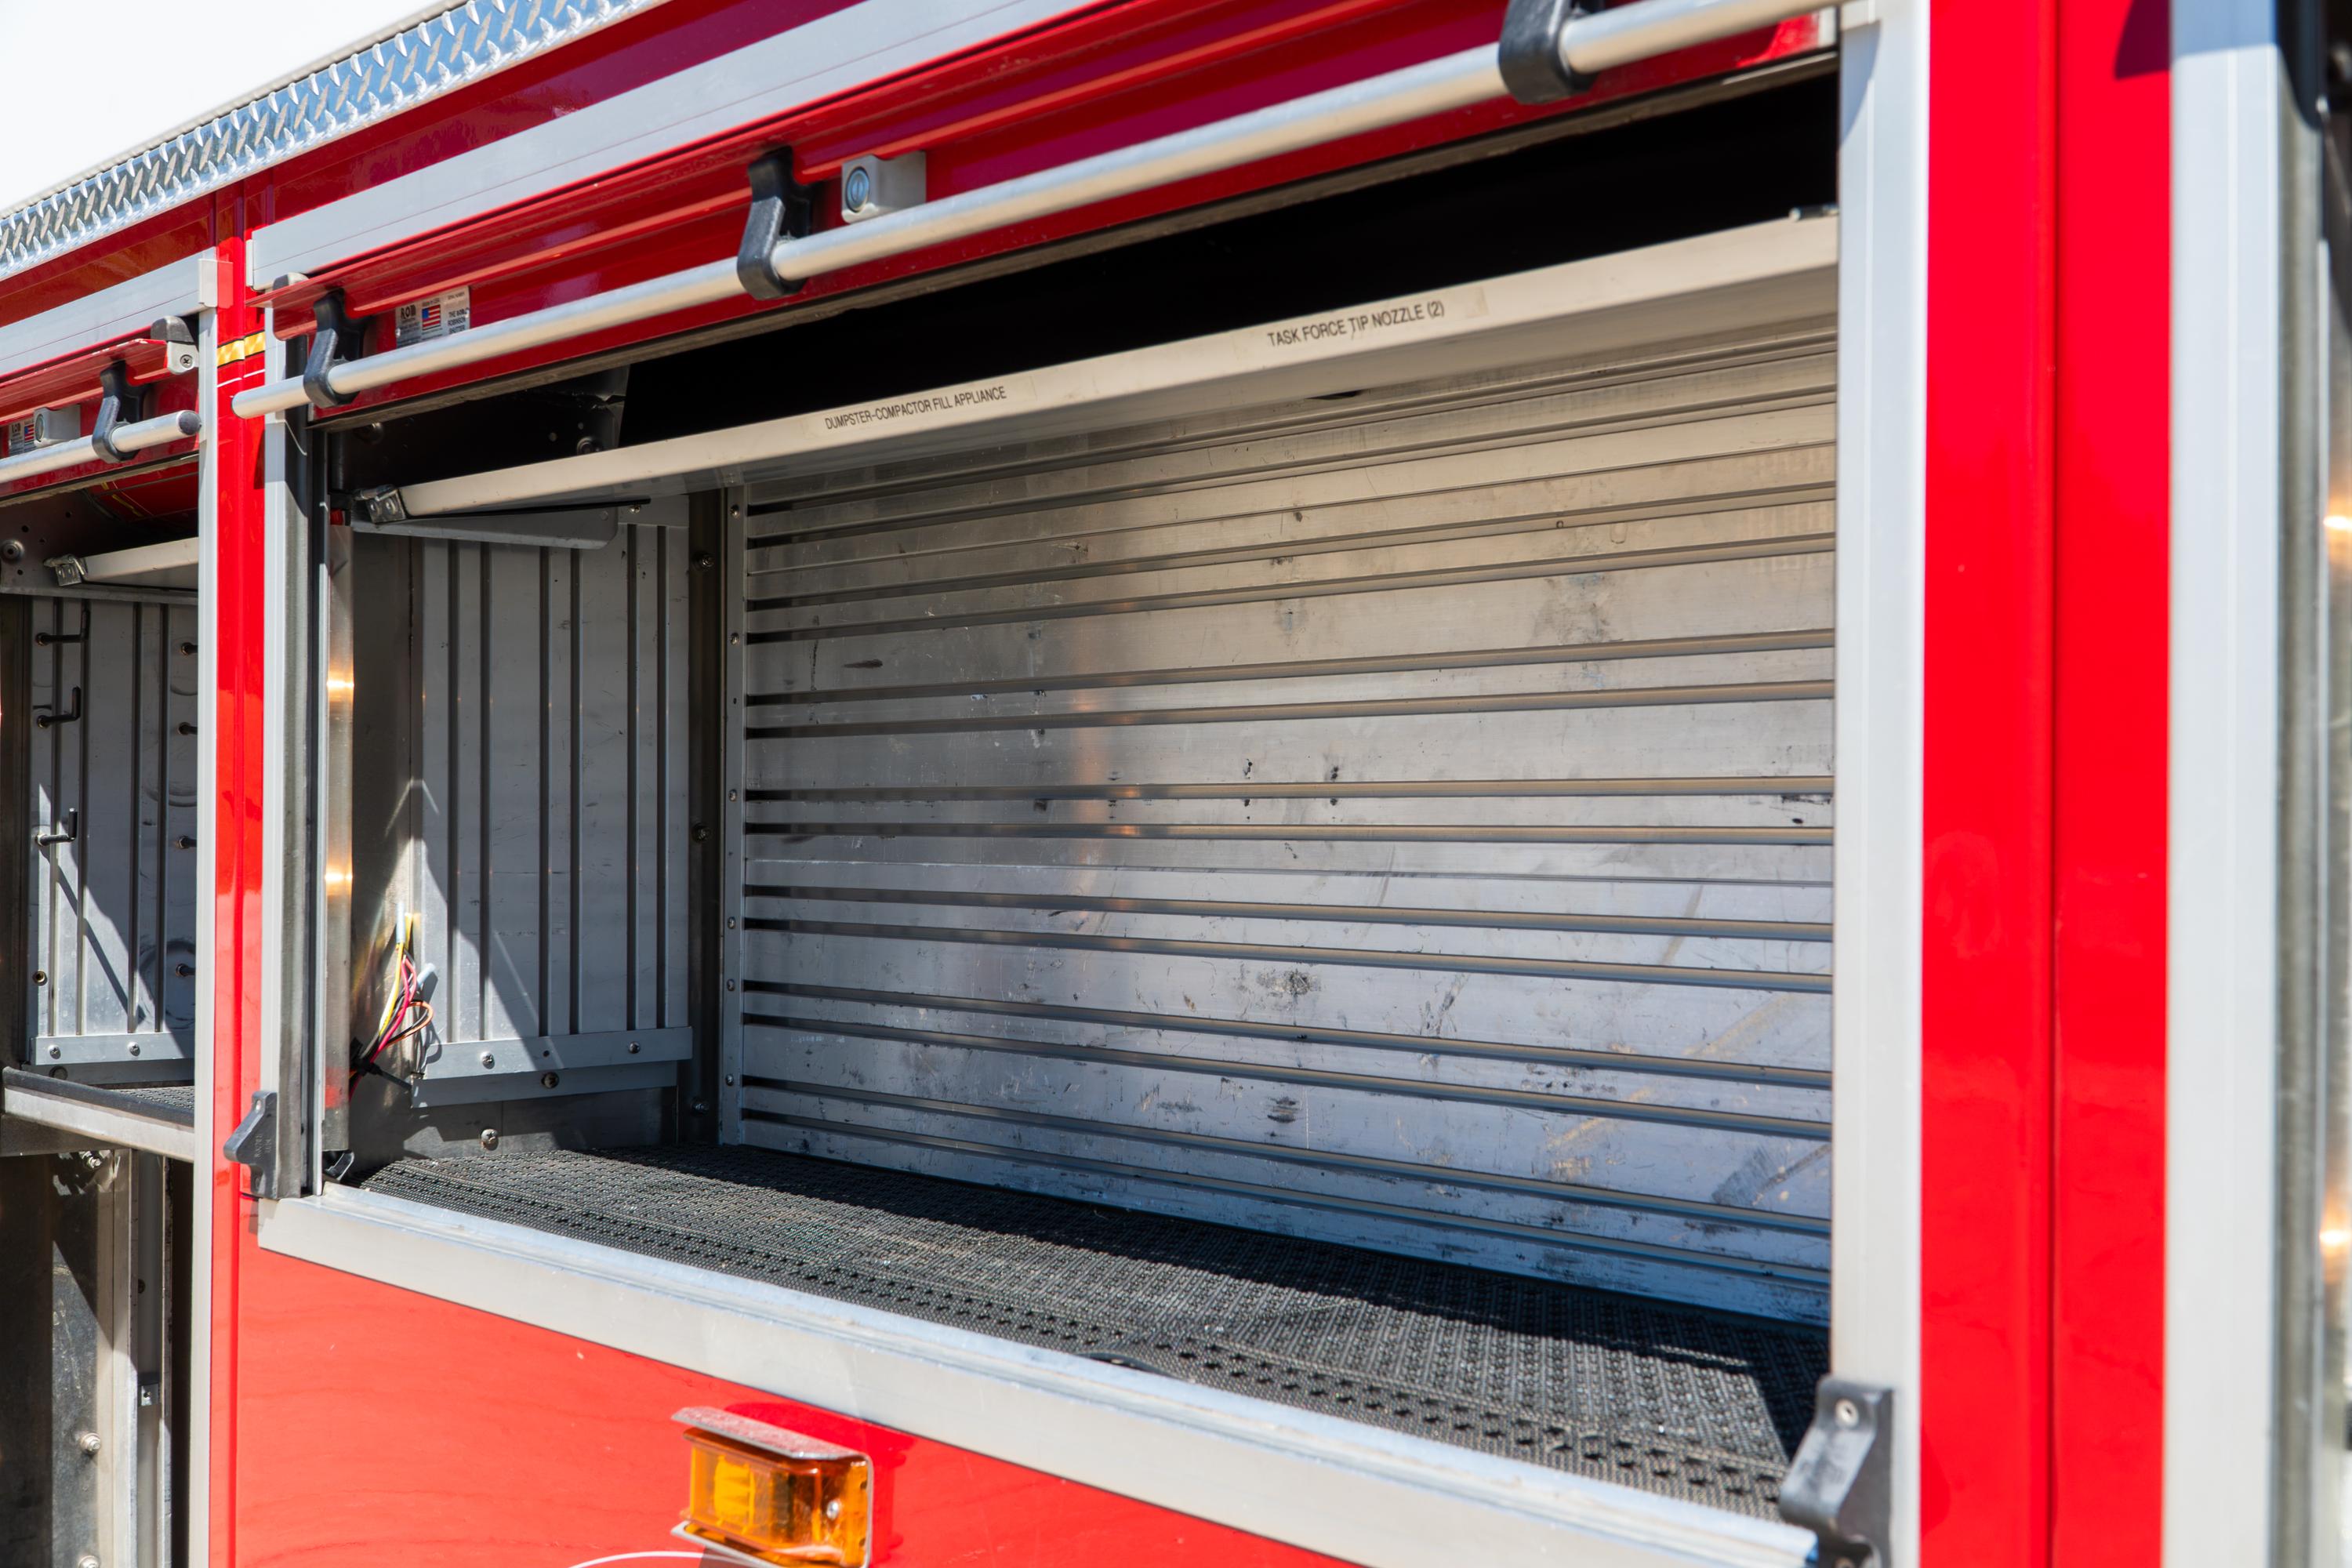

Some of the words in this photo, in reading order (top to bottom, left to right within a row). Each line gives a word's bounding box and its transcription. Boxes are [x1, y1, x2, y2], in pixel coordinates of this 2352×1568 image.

[1267, 329, 1301, 347] TASK
[1301, 320, 1347, 341] FORCE
[1348, 314, 1369, 333] TIP
[1371, 304, 1425, 328] NOZZLE
[1426, 300, 1445, 319] (2)
[825, 399, 932, 430] DUMPSTER-COMPACTOR
[932, 394, 953, 412] FILL
[954, 386, 1007, 407] APPLIANCE
